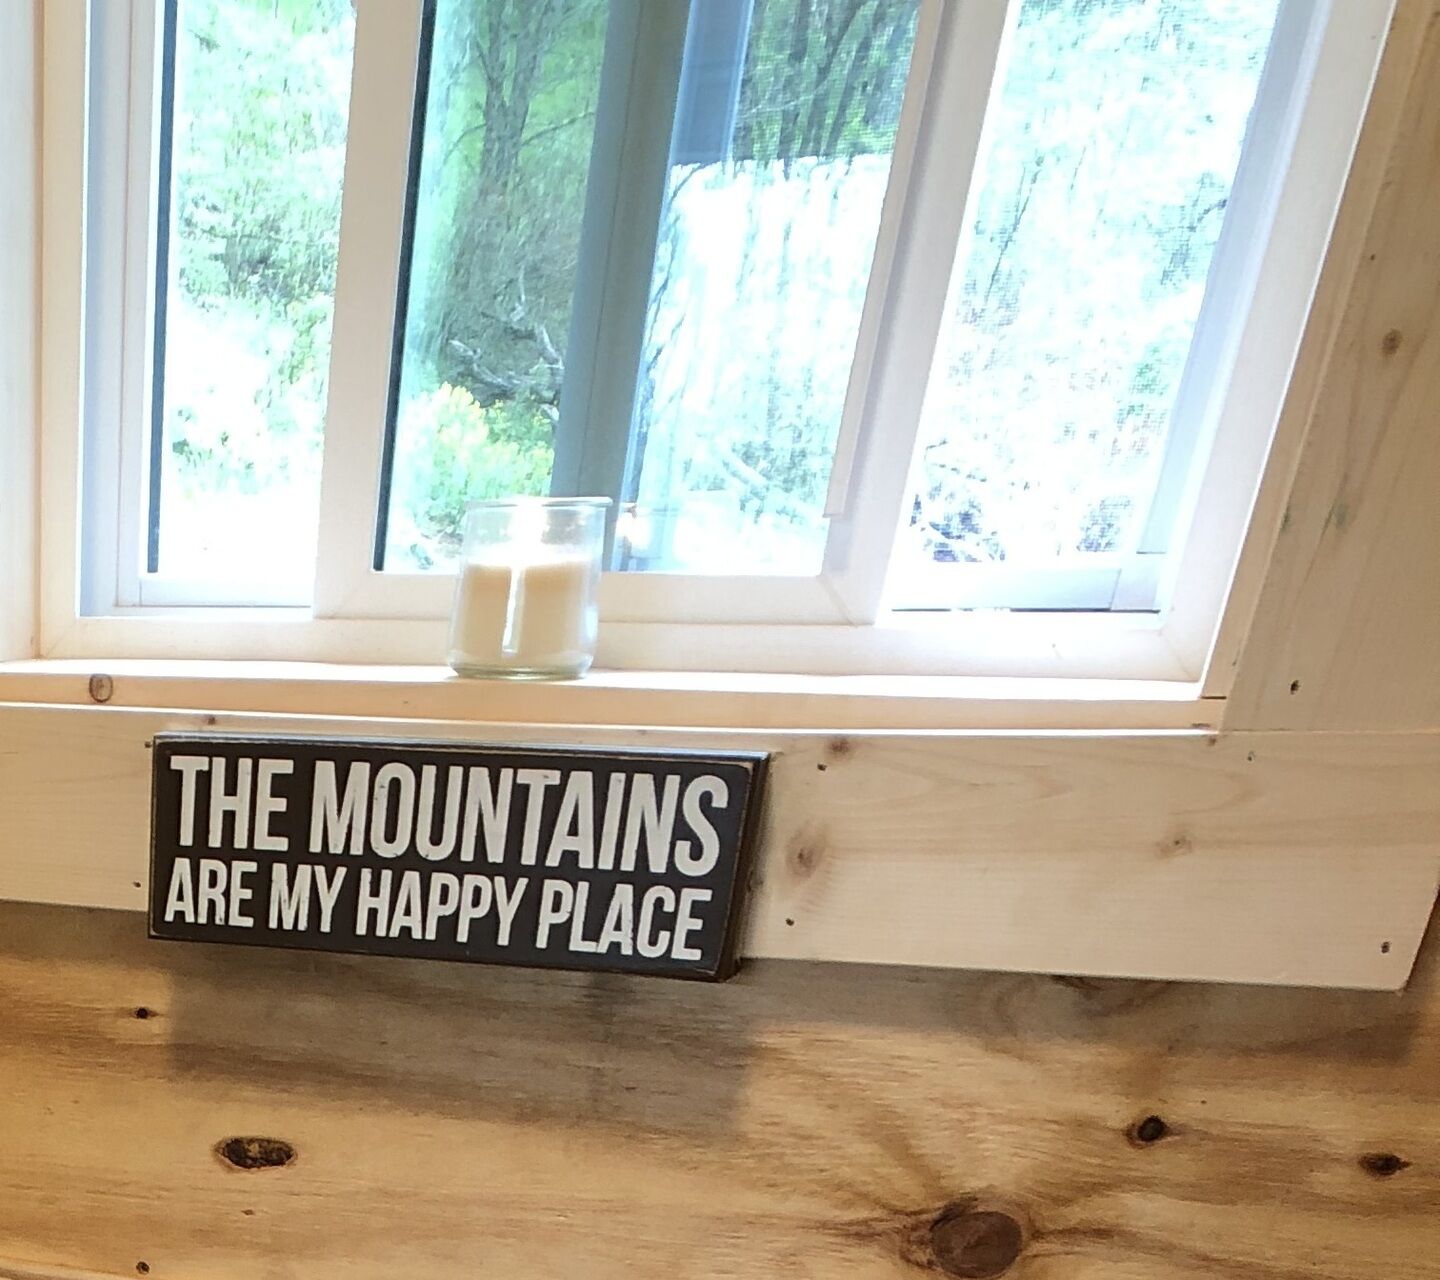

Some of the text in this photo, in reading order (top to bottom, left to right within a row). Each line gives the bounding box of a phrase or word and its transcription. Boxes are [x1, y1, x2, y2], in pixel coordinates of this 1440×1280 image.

[169, 755, 729, 877] THE MOUNTAINS
[164, 857, 713, 961] ARE MY HAPPY PLACE
